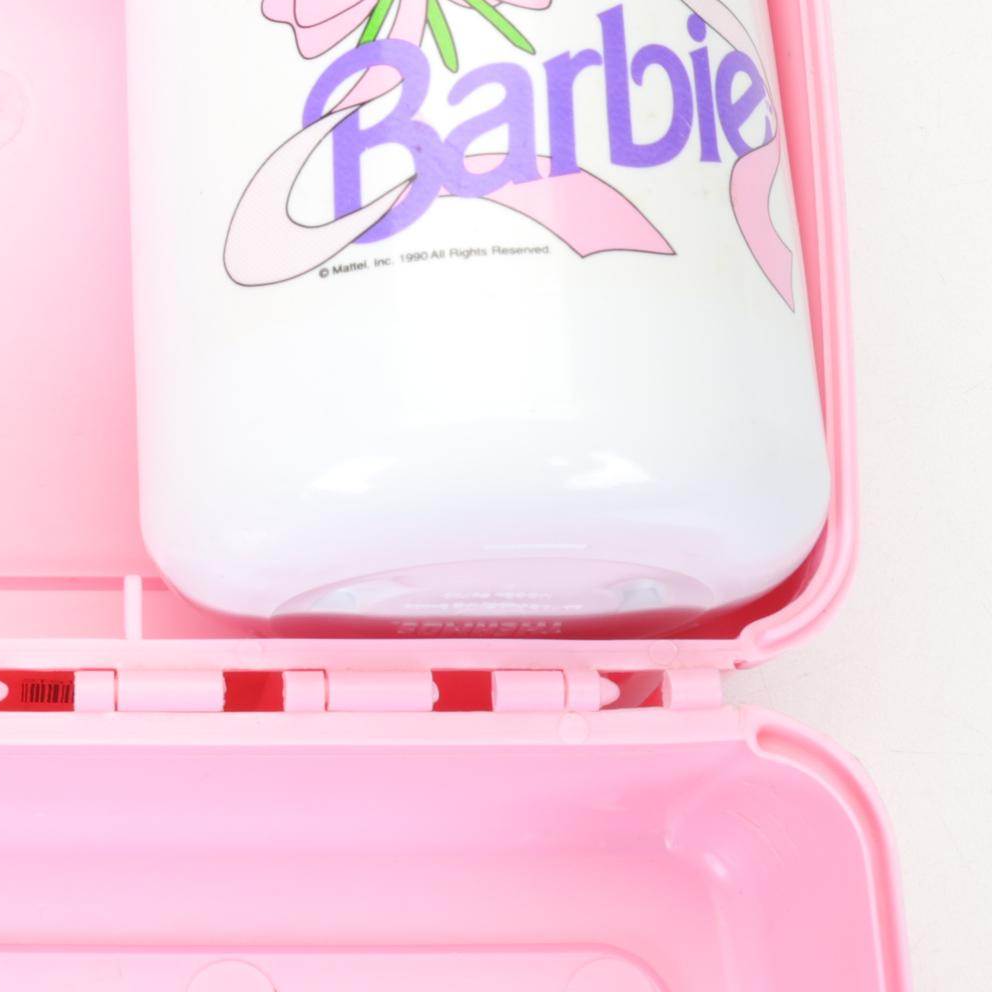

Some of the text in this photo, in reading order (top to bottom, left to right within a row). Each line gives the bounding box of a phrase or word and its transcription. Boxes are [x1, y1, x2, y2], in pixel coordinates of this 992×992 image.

[303, 4, 775, 244] Barbie
[374, 256, 394, 267] Inc.
[400, 251, 428, 263] 1990
[430, 248, 445, 260] All
[449, 247, 488, 258] Rights
[491, 244, 551, 256] Reserved.
